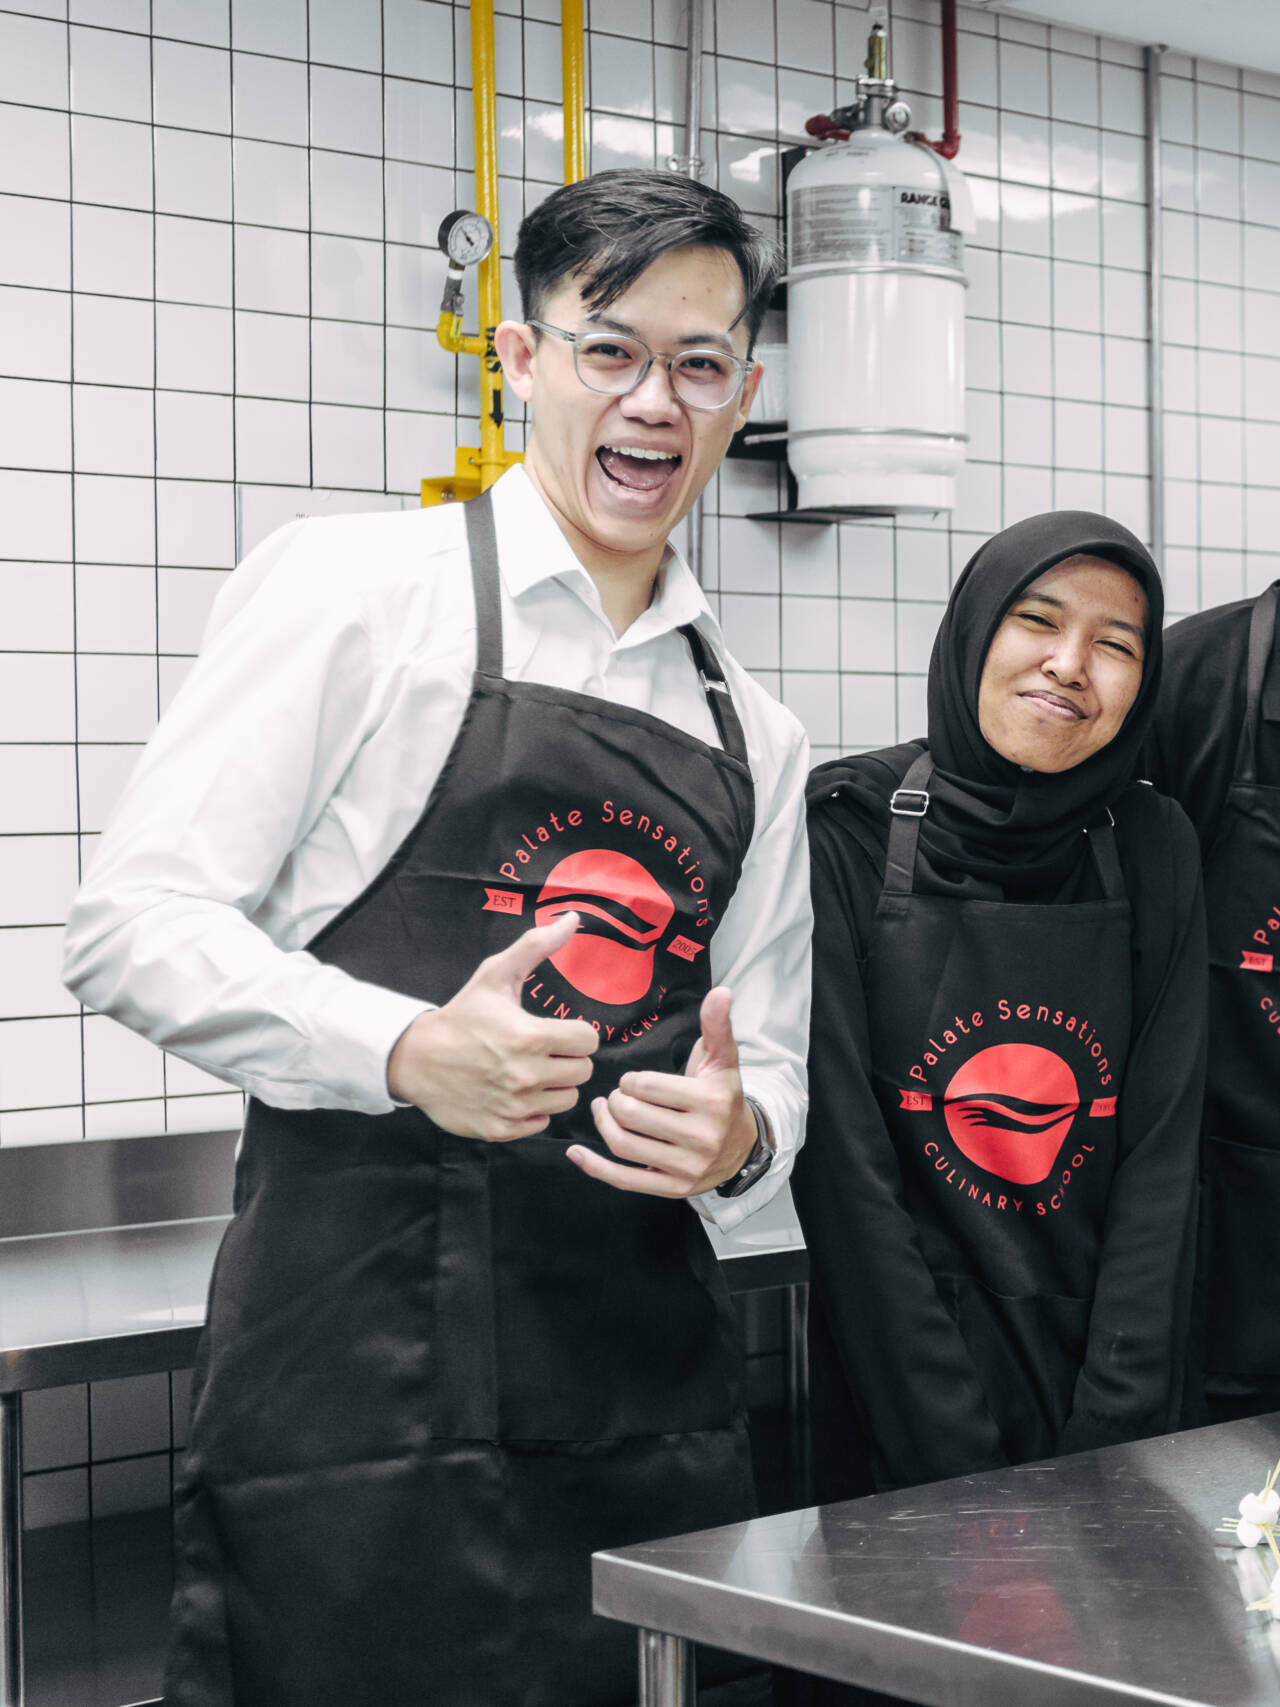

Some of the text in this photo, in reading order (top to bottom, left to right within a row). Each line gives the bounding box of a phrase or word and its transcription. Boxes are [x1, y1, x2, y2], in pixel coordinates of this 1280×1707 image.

[500, 800, 709, 928] Palate Sensations
[492, 895, 516, 908] EST
[909, 1000, 1112, 1086] Palate Sensations
[906, 1095, 925, 1105] EST
[924, 1142, 1023, 1212] CULINARY
